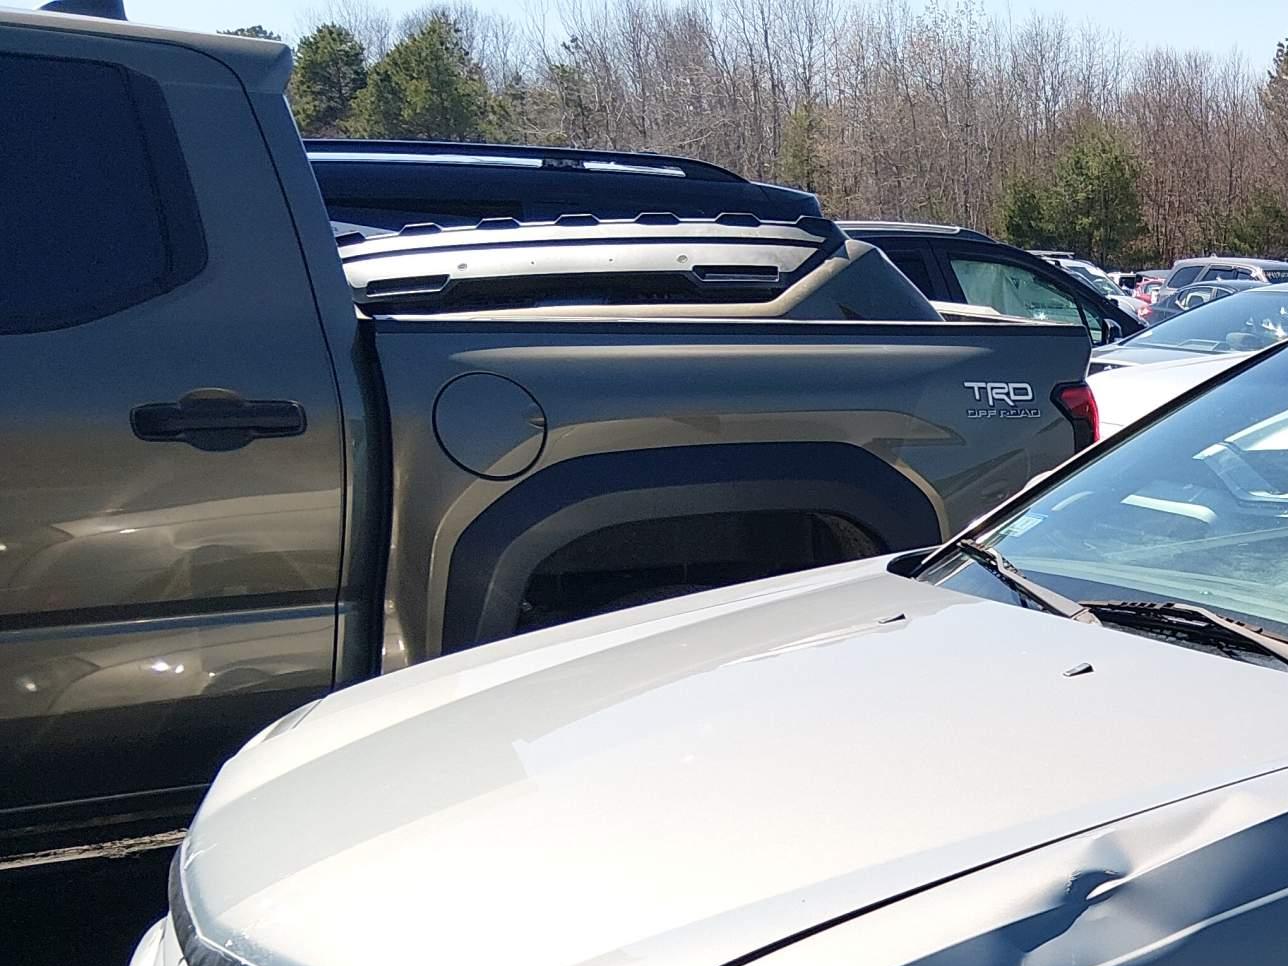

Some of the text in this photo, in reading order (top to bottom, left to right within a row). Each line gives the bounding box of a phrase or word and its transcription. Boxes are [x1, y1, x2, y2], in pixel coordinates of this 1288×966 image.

[963, 381, 1033, 407] TRD
[967, 409, 1041, 418] OFF ROAD
